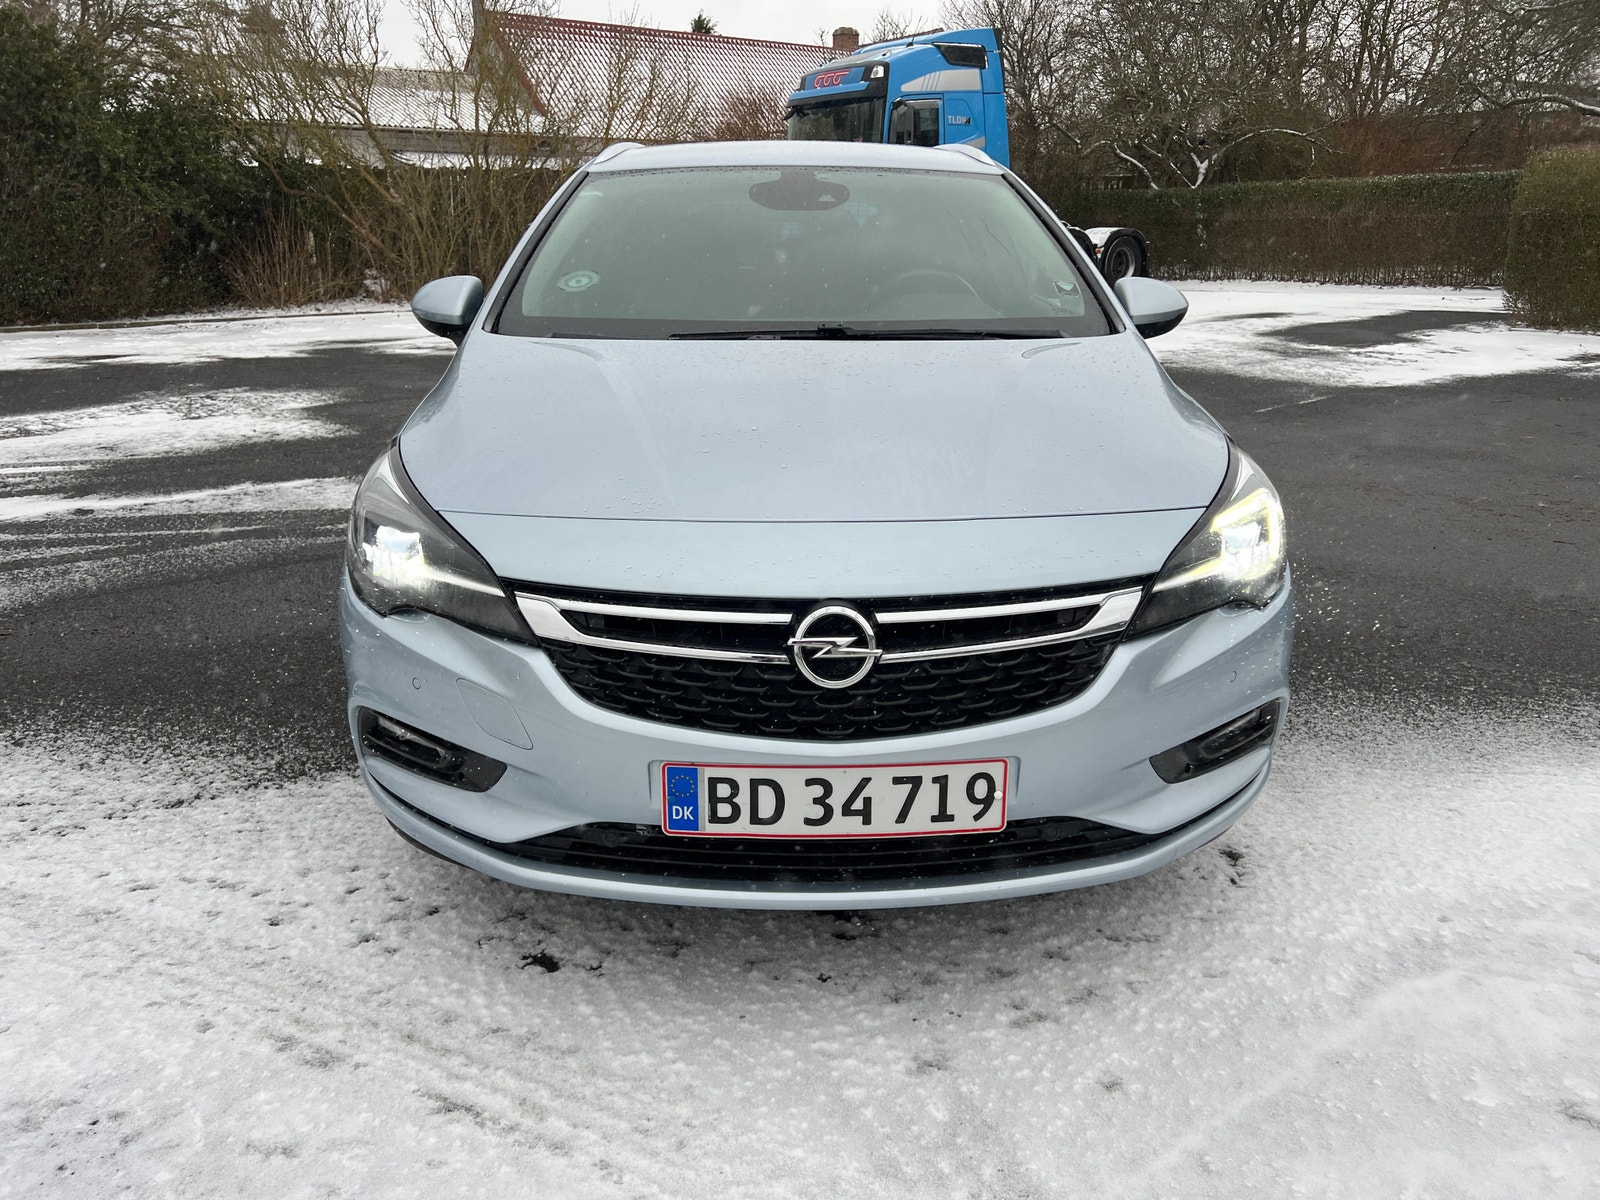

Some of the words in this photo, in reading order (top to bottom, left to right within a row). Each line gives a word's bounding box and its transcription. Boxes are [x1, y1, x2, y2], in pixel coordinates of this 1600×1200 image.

[810, 607, 860, 620] OPEL
[707, 776, 786, 826] BD
[803, 776, 873, 827] 34
[891, 771, 997, 824] 719
[672, 805, 694, 820] DK
